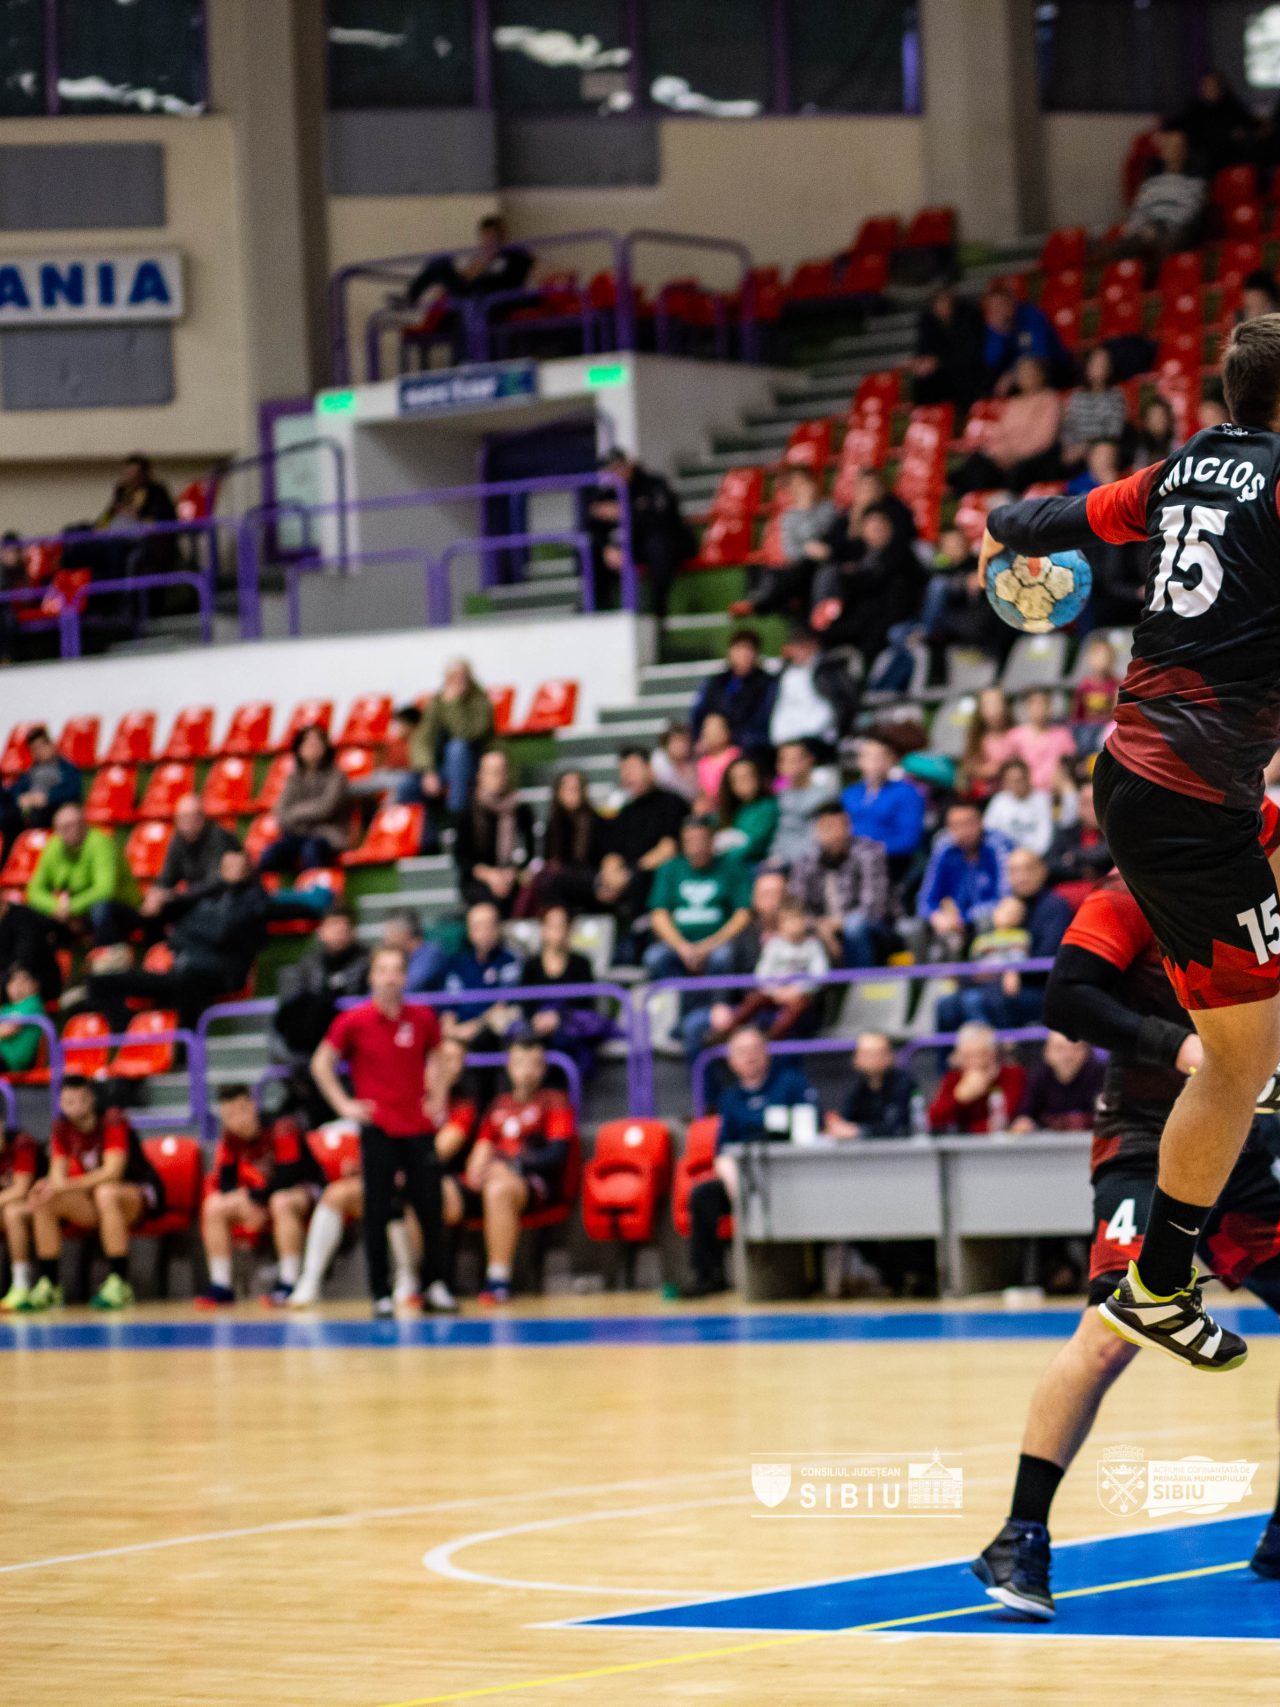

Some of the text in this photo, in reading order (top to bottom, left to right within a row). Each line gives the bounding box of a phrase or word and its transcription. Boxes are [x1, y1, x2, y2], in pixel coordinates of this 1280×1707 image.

[0, 261, 171, 308] ANIA
[1150, 504, 1230, 618] 15
[1105, 1198, 1138, 1246] 4
